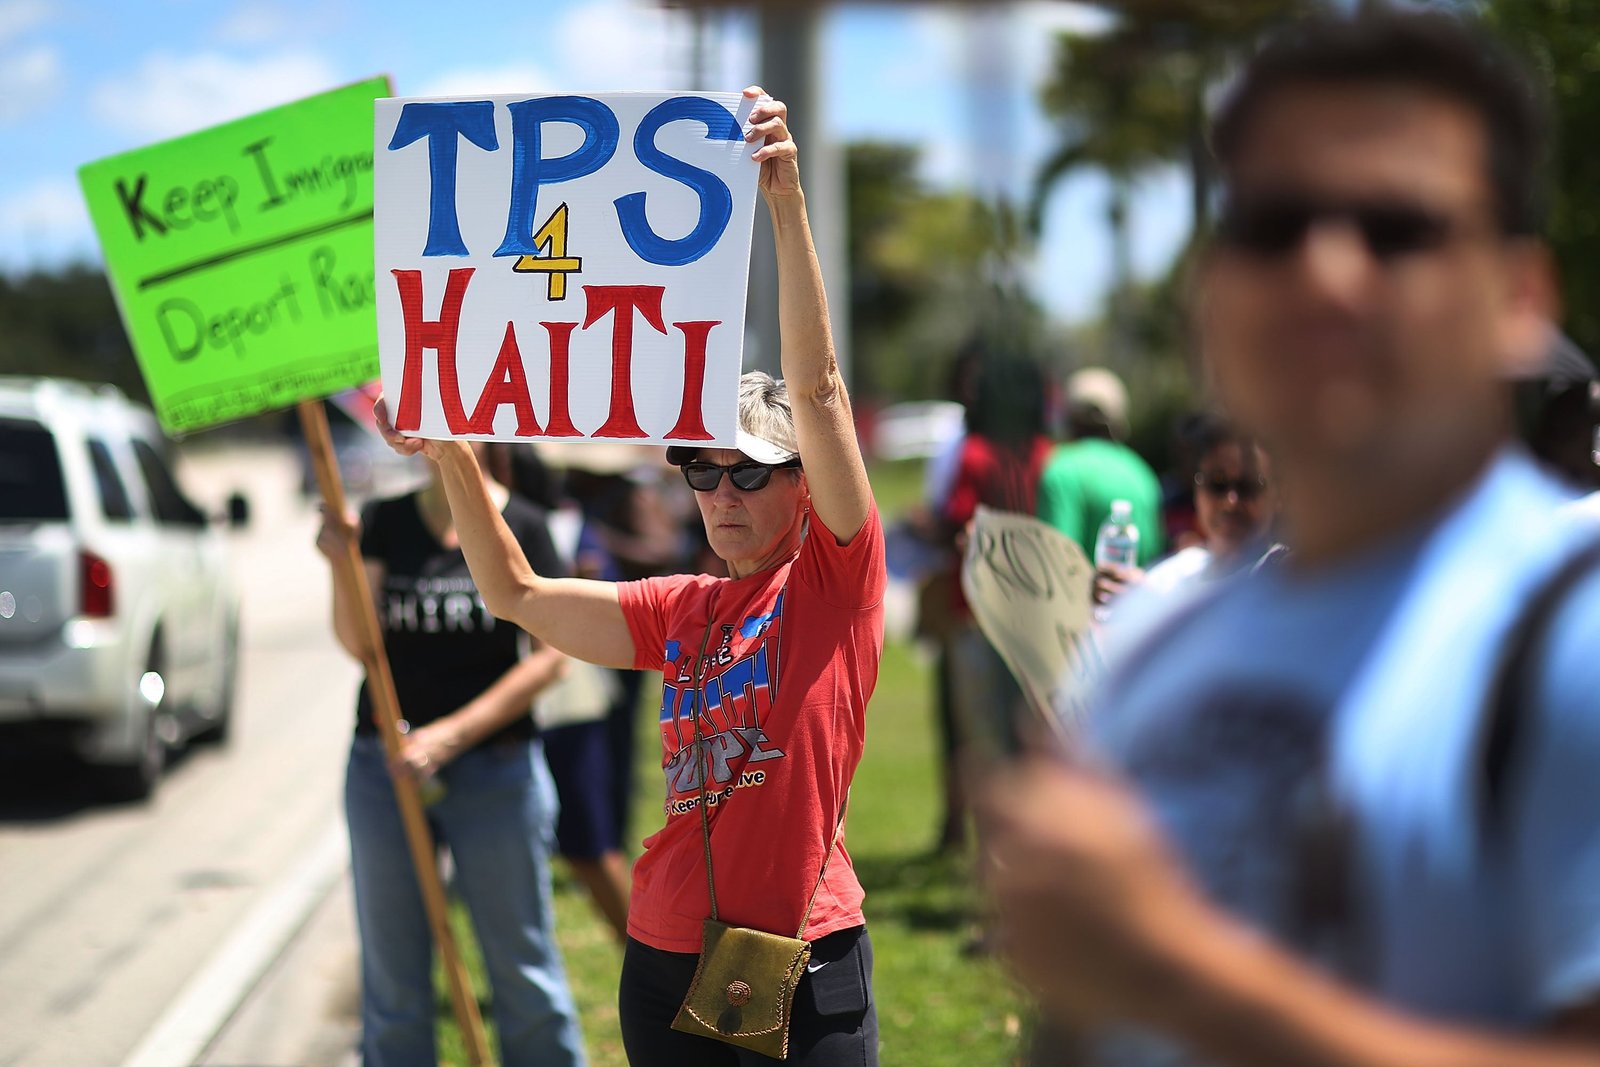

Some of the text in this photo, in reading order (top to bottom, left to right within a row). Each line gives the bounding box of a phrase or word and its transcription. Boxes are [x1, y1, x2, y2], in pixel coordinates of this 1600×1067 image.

[114, 172, 239, 243] Keep
[387, 95, 744, 267] TPS
[512, 201, 582, 301] 4
[155, 271, 304, 363] Deport
[390, 267, 723, 440] HAITI
[378, 594, 496, 632] HIRT
